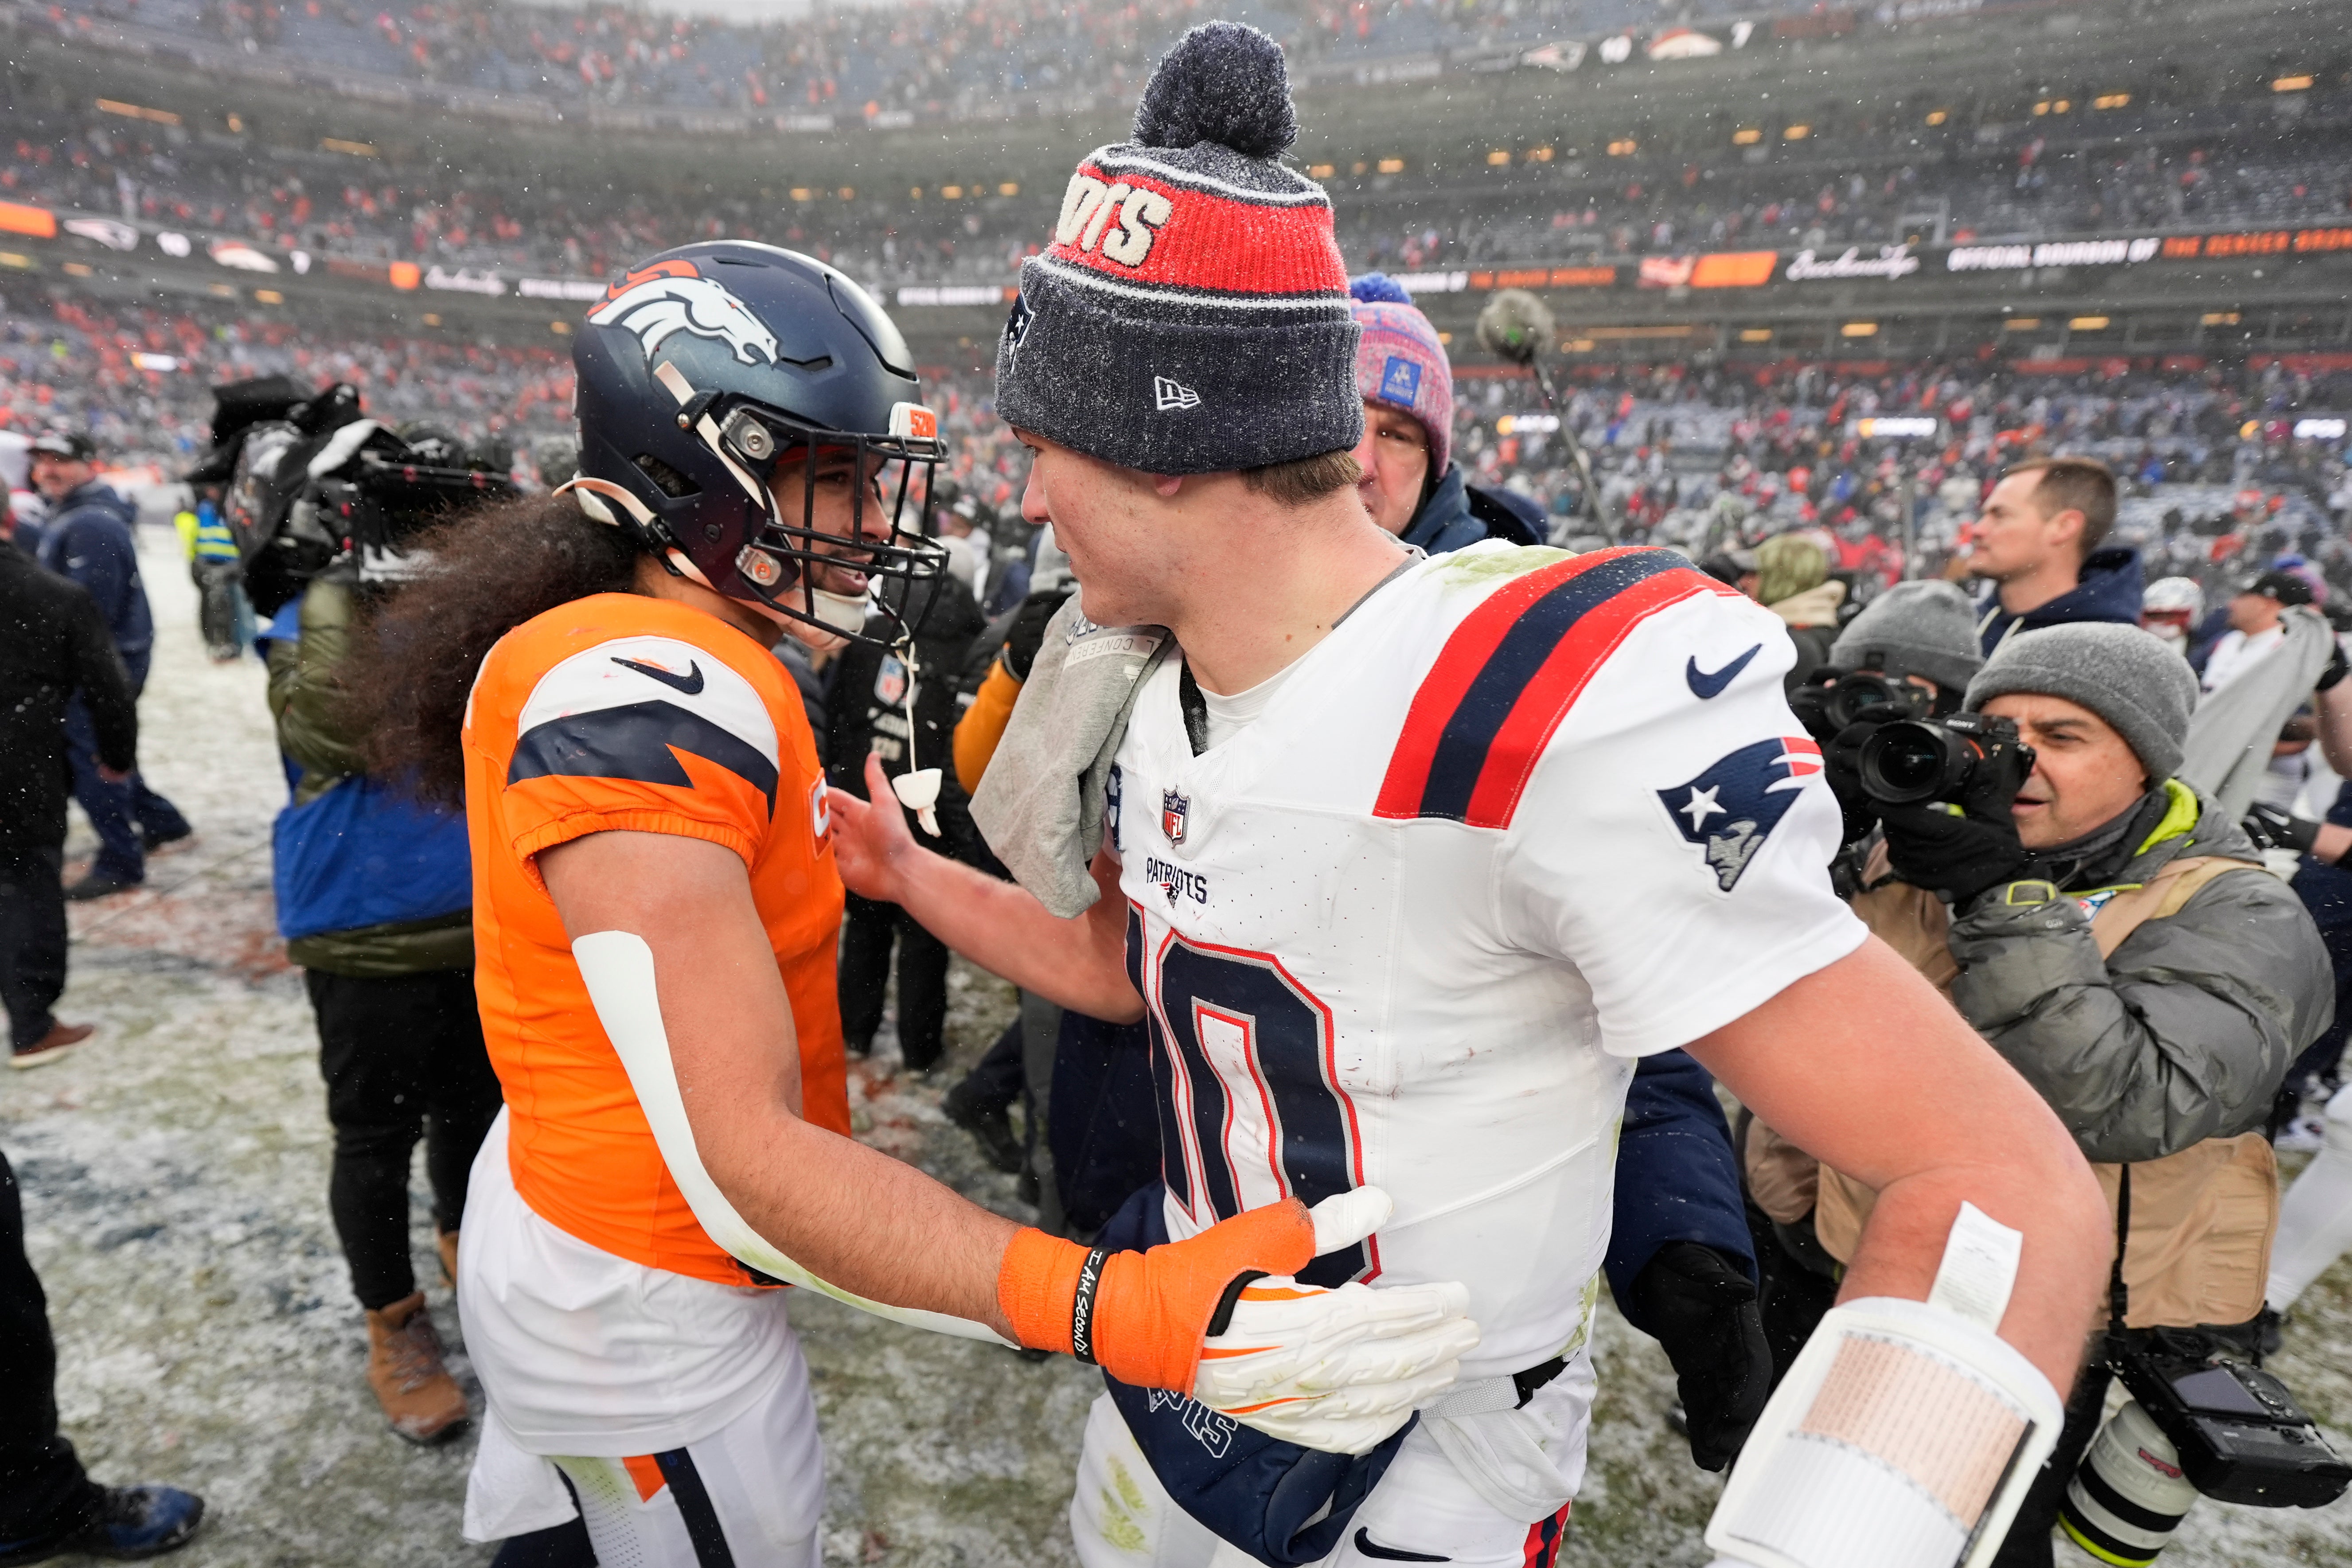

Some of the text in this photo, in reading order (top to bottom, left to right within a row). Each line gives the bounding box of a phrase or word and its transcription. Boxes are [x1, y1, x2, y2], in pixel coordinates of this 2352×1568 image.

[1064, 638, 1134, 664] CONFEREN
[1946, 719, 1977, 729] SONY
[1164, 811, 1182, 837] NFL
[1147, 857, 1208, 904] PATRIOTS
[1088, 1250, 1103, 1266] I
[1079, 1266, 1096, 1295] AM
